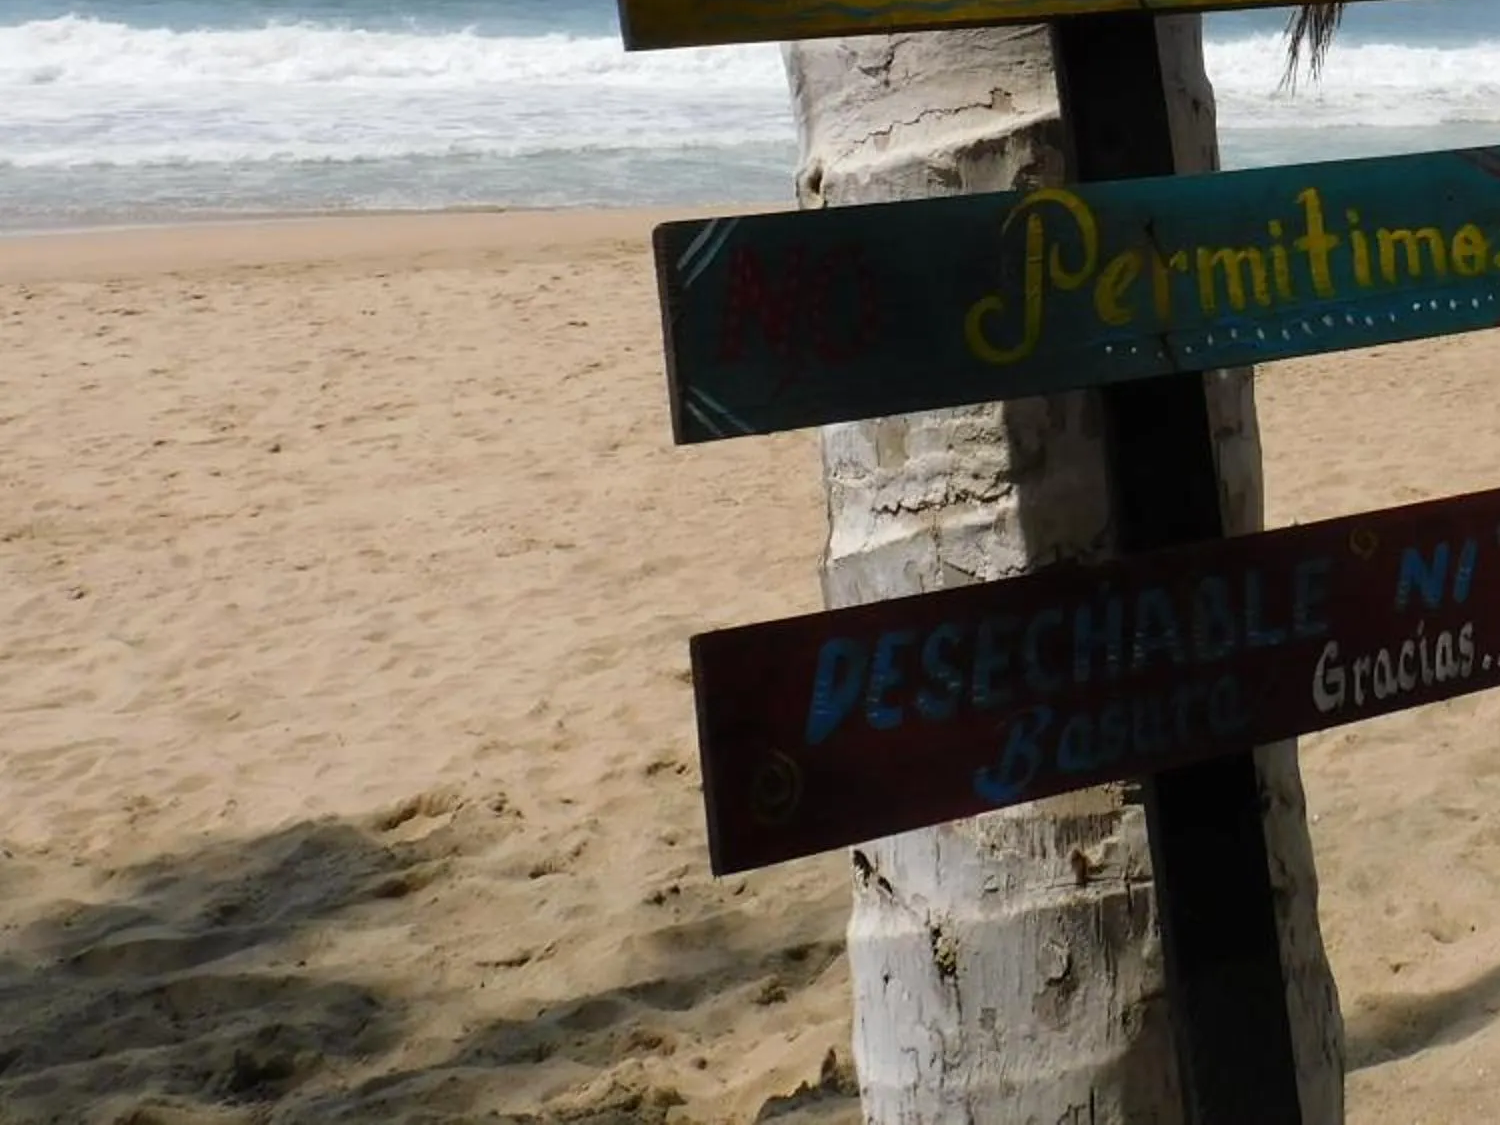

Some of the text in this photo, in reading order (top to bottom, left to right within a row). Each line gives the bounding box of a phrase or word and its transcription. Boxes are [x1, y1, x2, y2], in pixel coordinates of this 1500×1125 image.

[719, 240, 882, 365] NO
[805, 557, 1332, 745] DESECHABLE
[972, 673, 1252, 803] Basura
